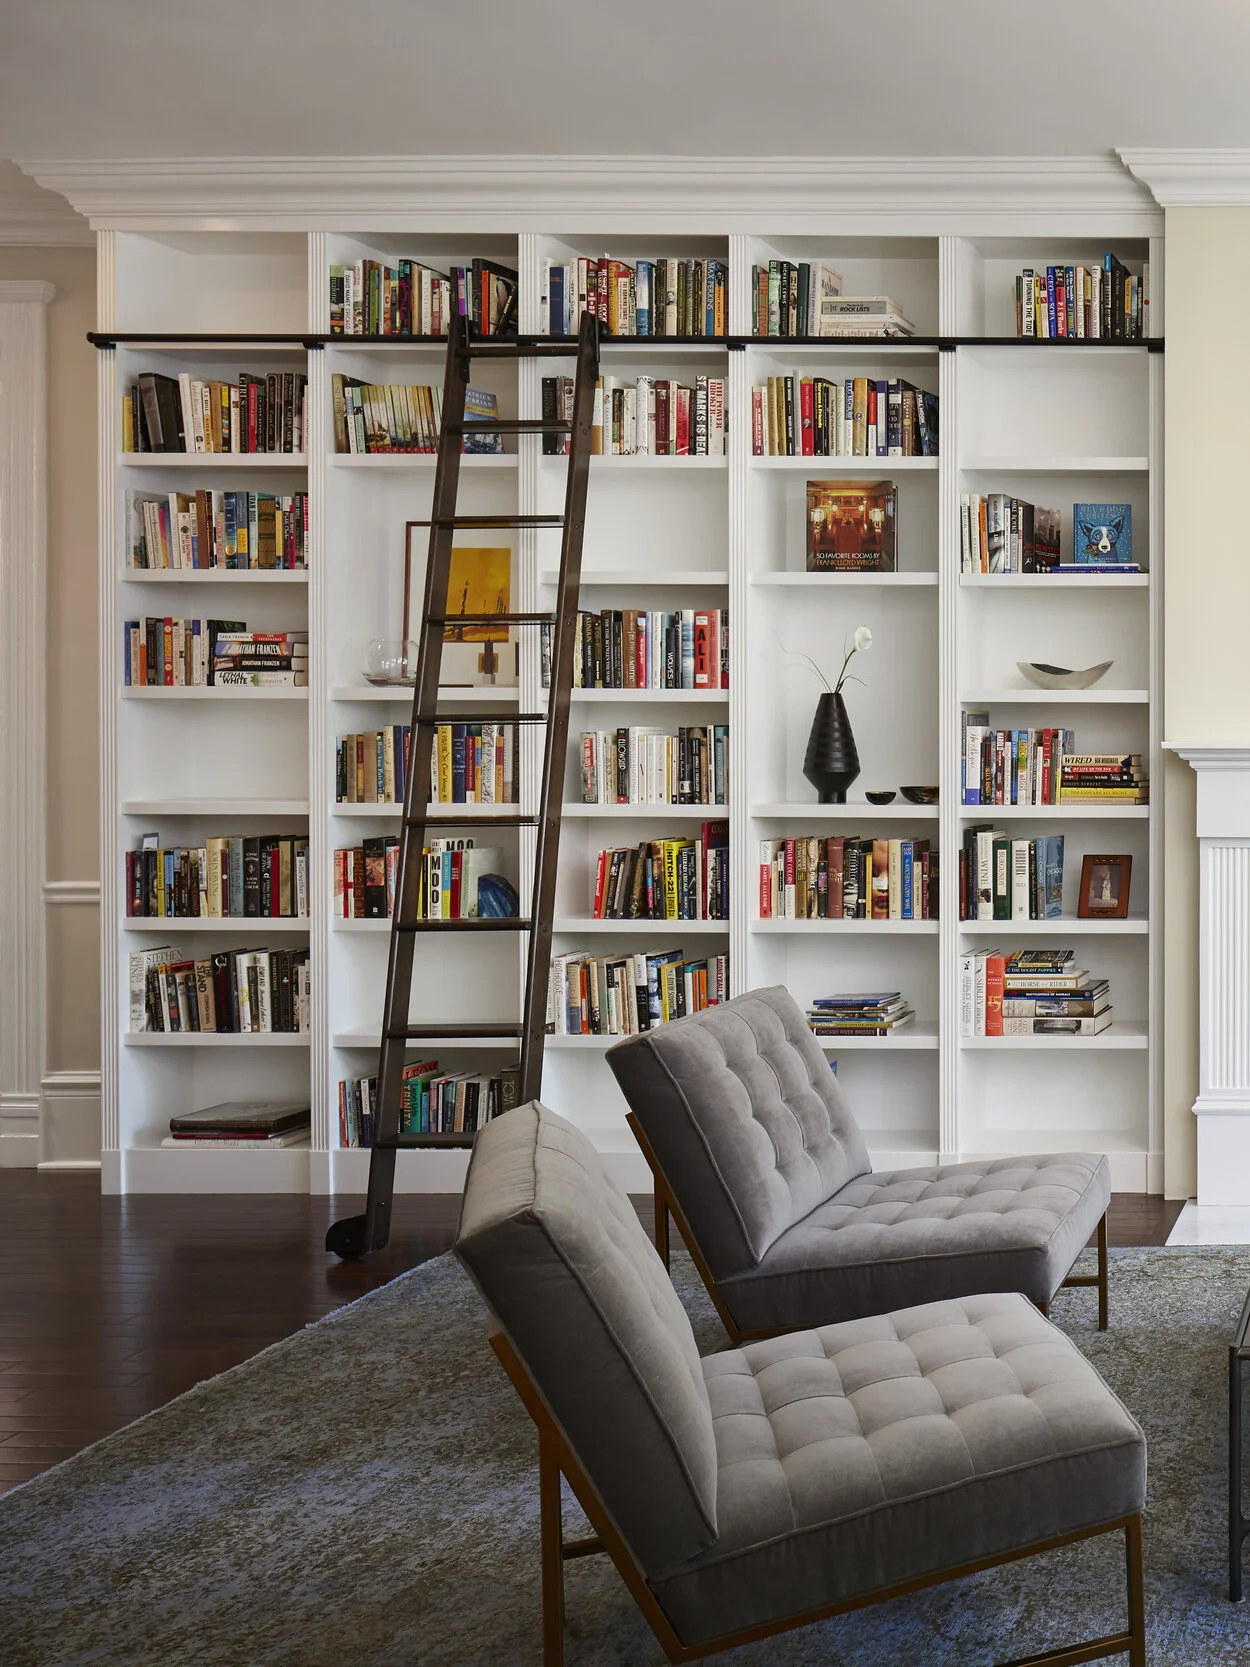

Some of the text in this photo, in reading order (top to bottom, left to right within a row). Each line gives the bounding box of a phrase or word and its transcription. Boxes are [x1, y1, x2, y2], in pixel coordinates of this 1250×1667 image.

[1025, 279, 1033, 333] TURNING THE TIDE
[696, 375, 707, 389] ST.
[696, 390, 707, 421] MARKS
[696, 424, 707, 433] IS
[697, 629, 706, 671] ALI
[223, 677, 248, 685] WHITE
[998, 851, 1006, 887] BURGUNDY
[130, 956, 138, 983] KING
[197, 965, 206, 993] STAND
[554, 960, 563, 994] HOTHOUSE
